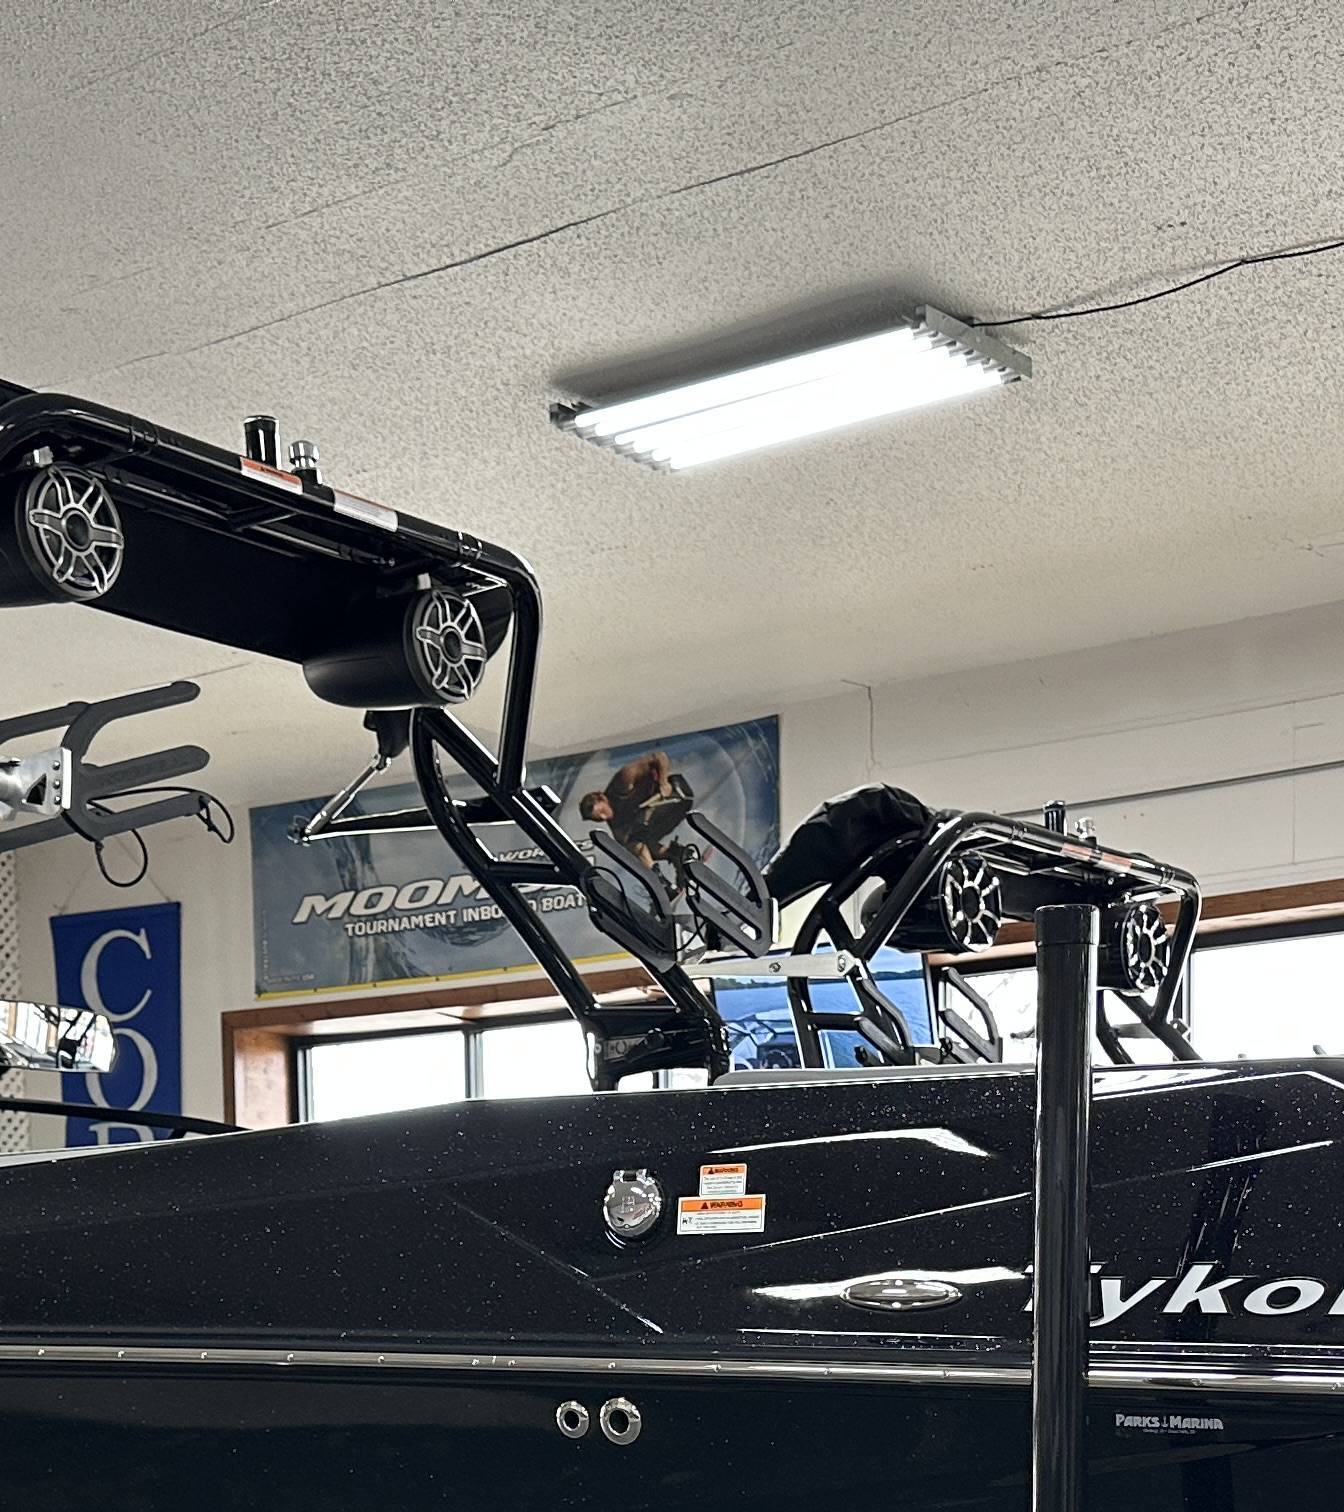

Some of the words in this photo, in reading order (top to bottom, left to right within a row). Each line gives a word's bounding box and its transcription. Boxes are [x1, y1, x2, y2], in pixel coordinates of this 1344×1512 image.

[292, 873, 562, 923] MOOM
[345, 909, 457, 937] TOURNAMENT
[462, 899, 537, 922] INBOD
[80, 928, 159, 1144] CO
[1115, 1413, 1161, 1428] PARKS
